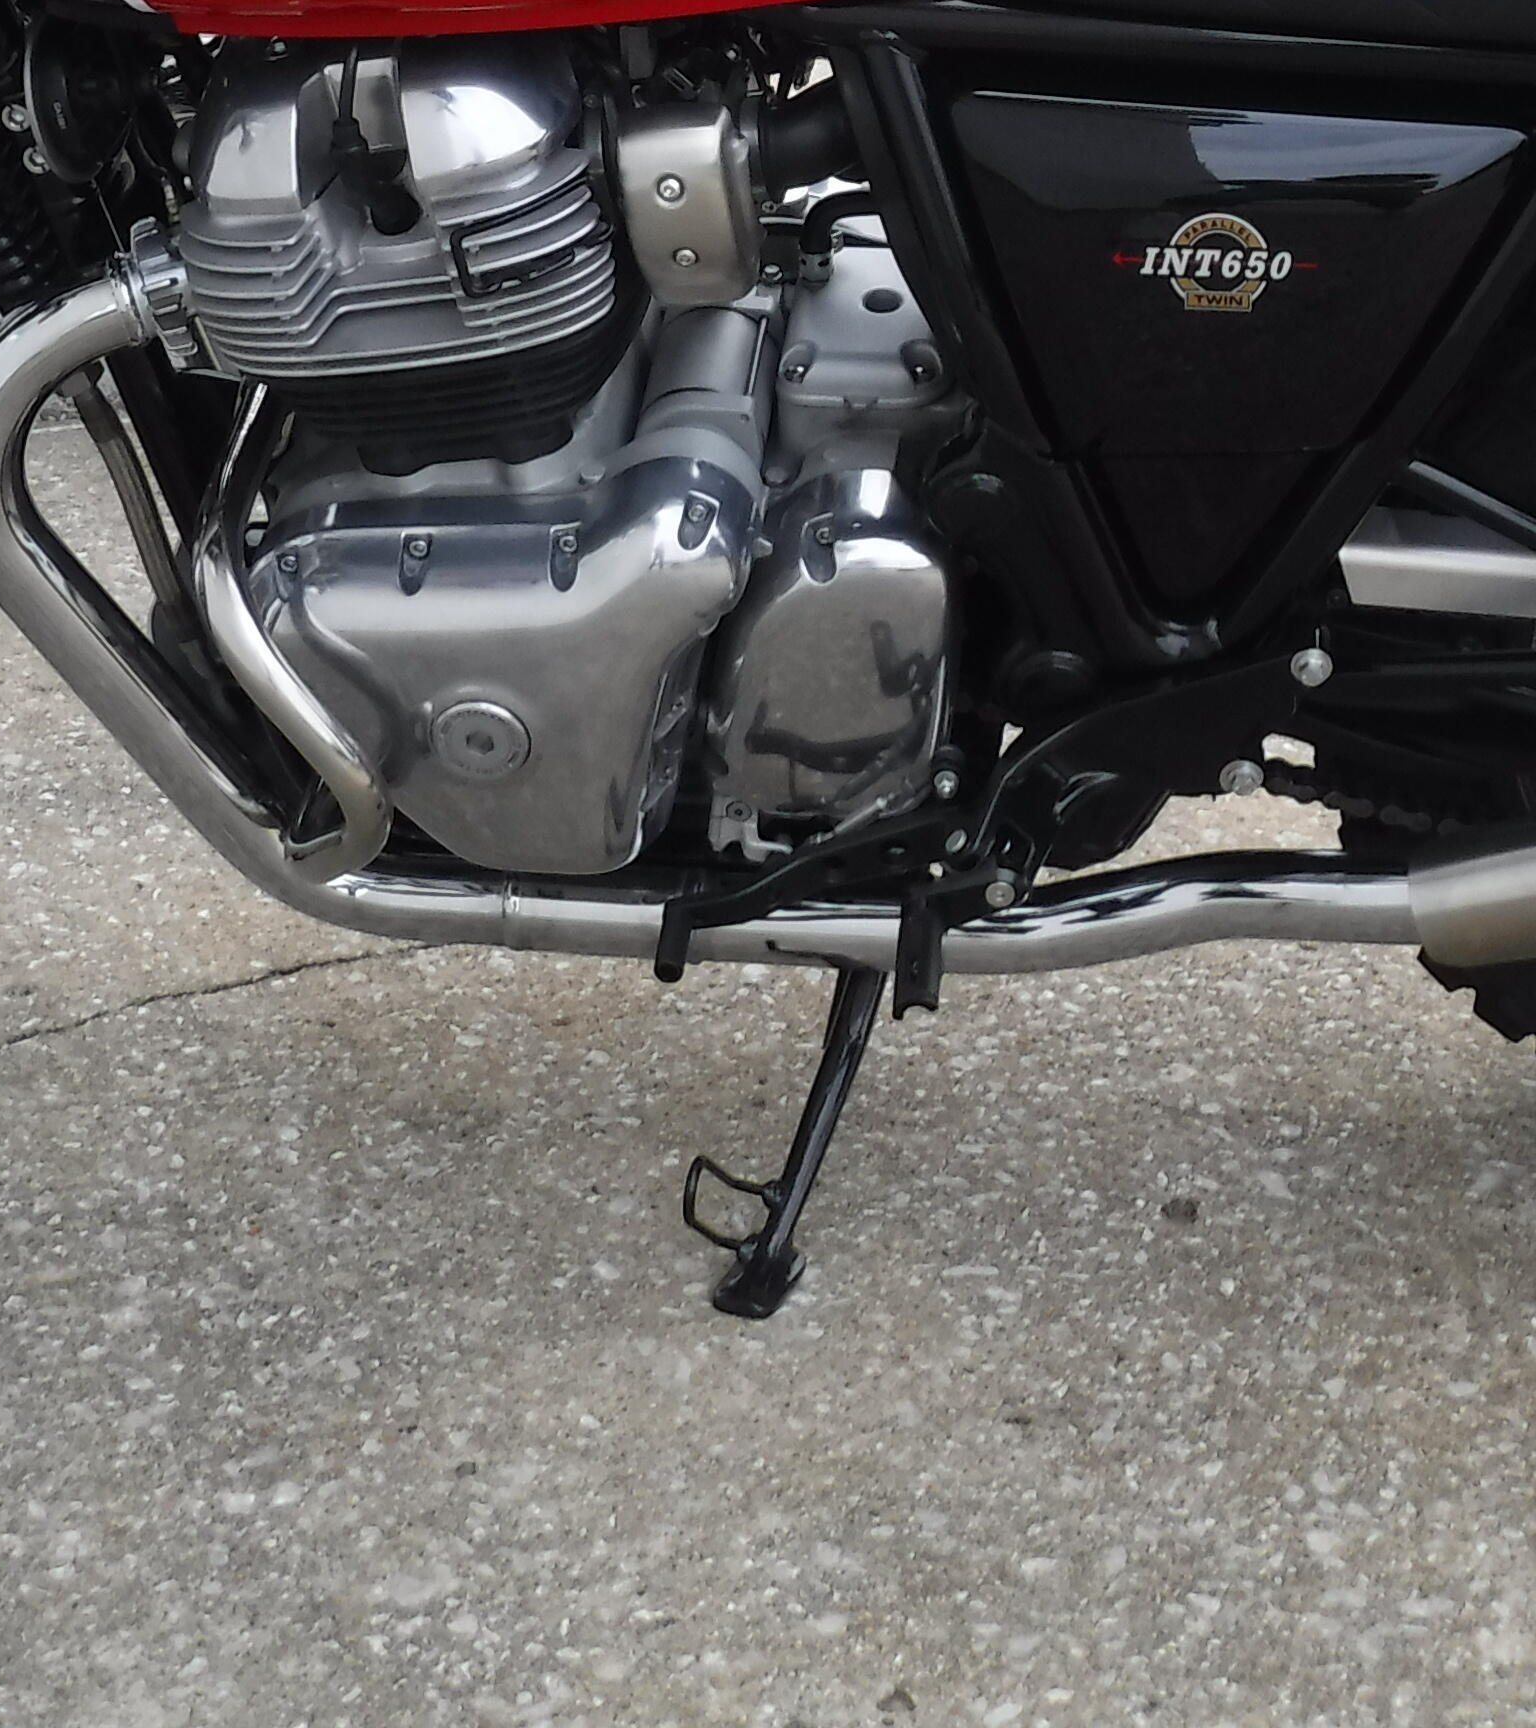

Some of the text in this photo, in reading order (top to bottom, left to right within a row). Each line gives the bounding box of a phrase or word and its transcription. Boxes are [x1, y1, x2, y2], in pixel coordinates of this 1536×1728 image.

[1184, 219, 1252, 241] PARALLEL
[1139, 246, 1292, 280] INT650
[1194, 294, 1243, 306] TWIN
